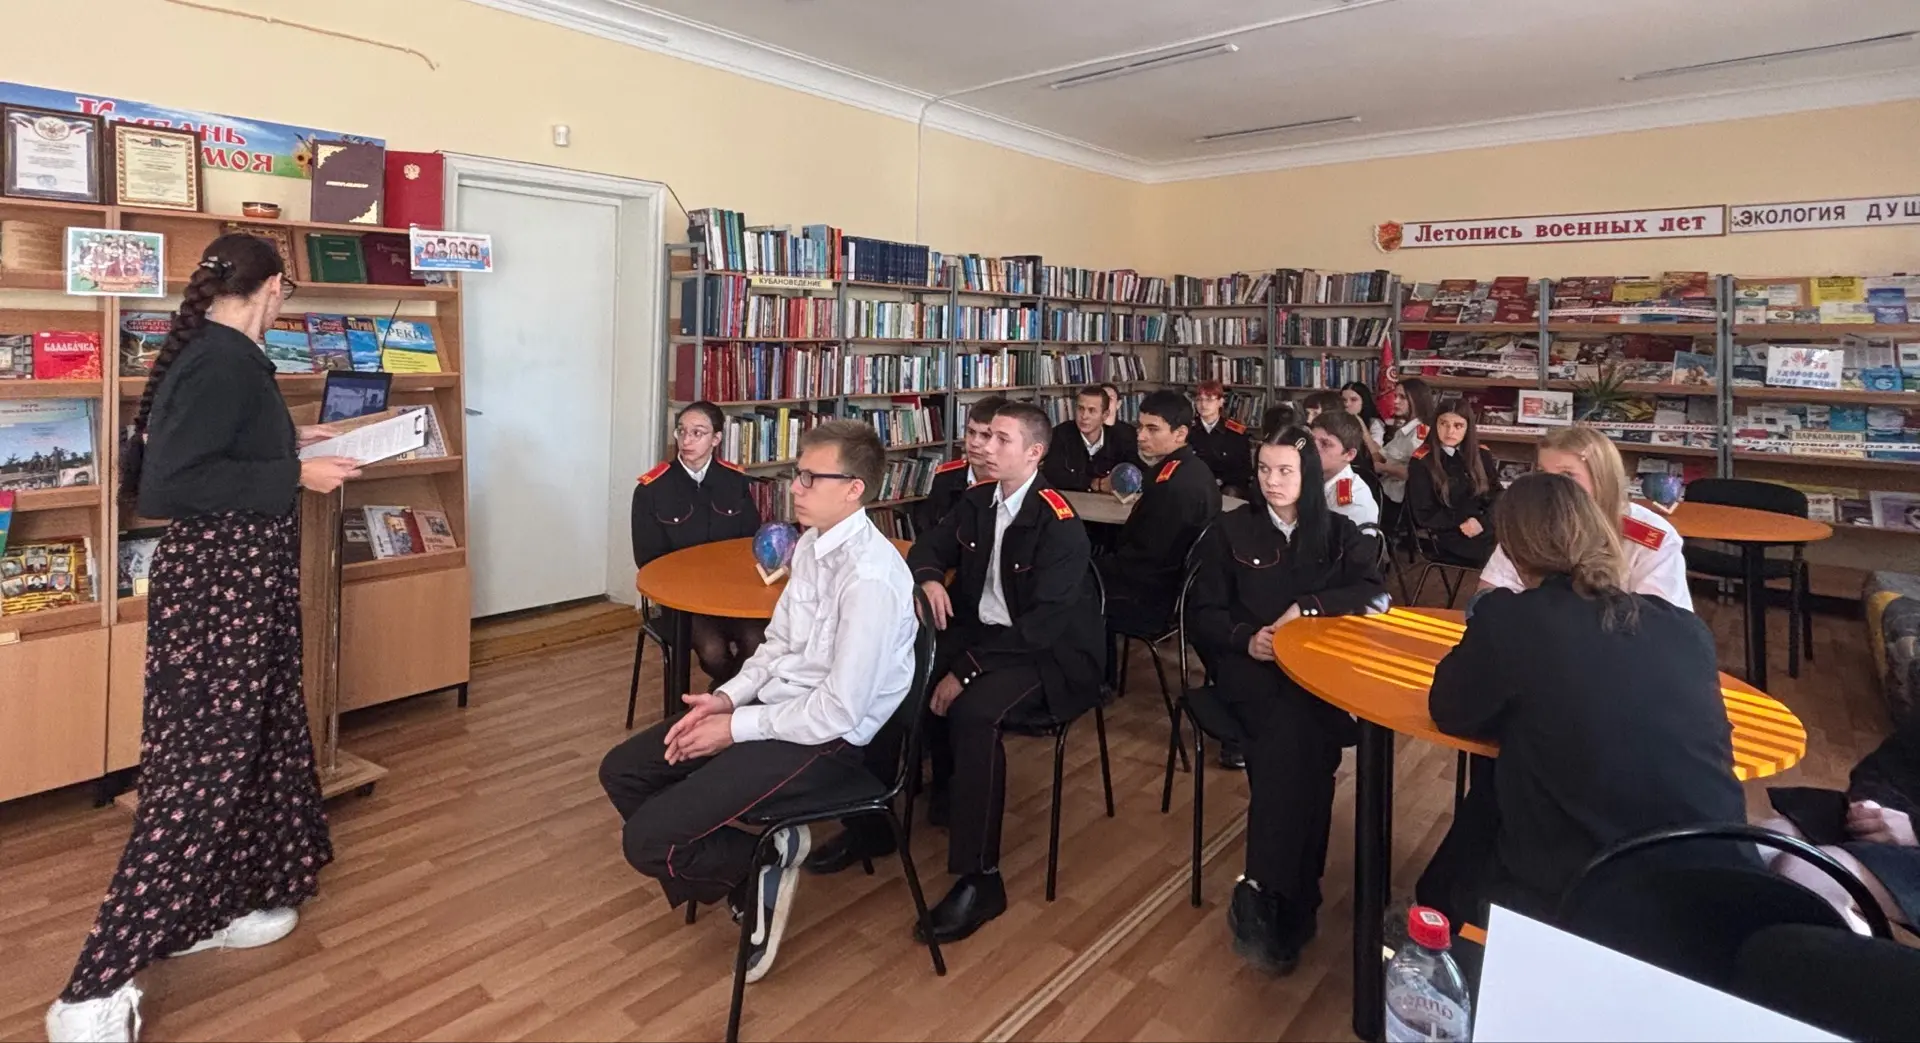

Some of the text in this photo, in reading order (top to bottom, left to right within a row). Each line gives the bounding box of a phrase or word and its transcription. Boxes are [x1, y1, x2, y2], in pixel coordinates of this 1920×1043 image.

[1740, 205, 1846, 225] ЭКОЛОГИЯ
[1415, 214, 1708, 243] Летопись военных лет
[759, 277, 822, 287] КУБАНОВЕДЕНИЕ
